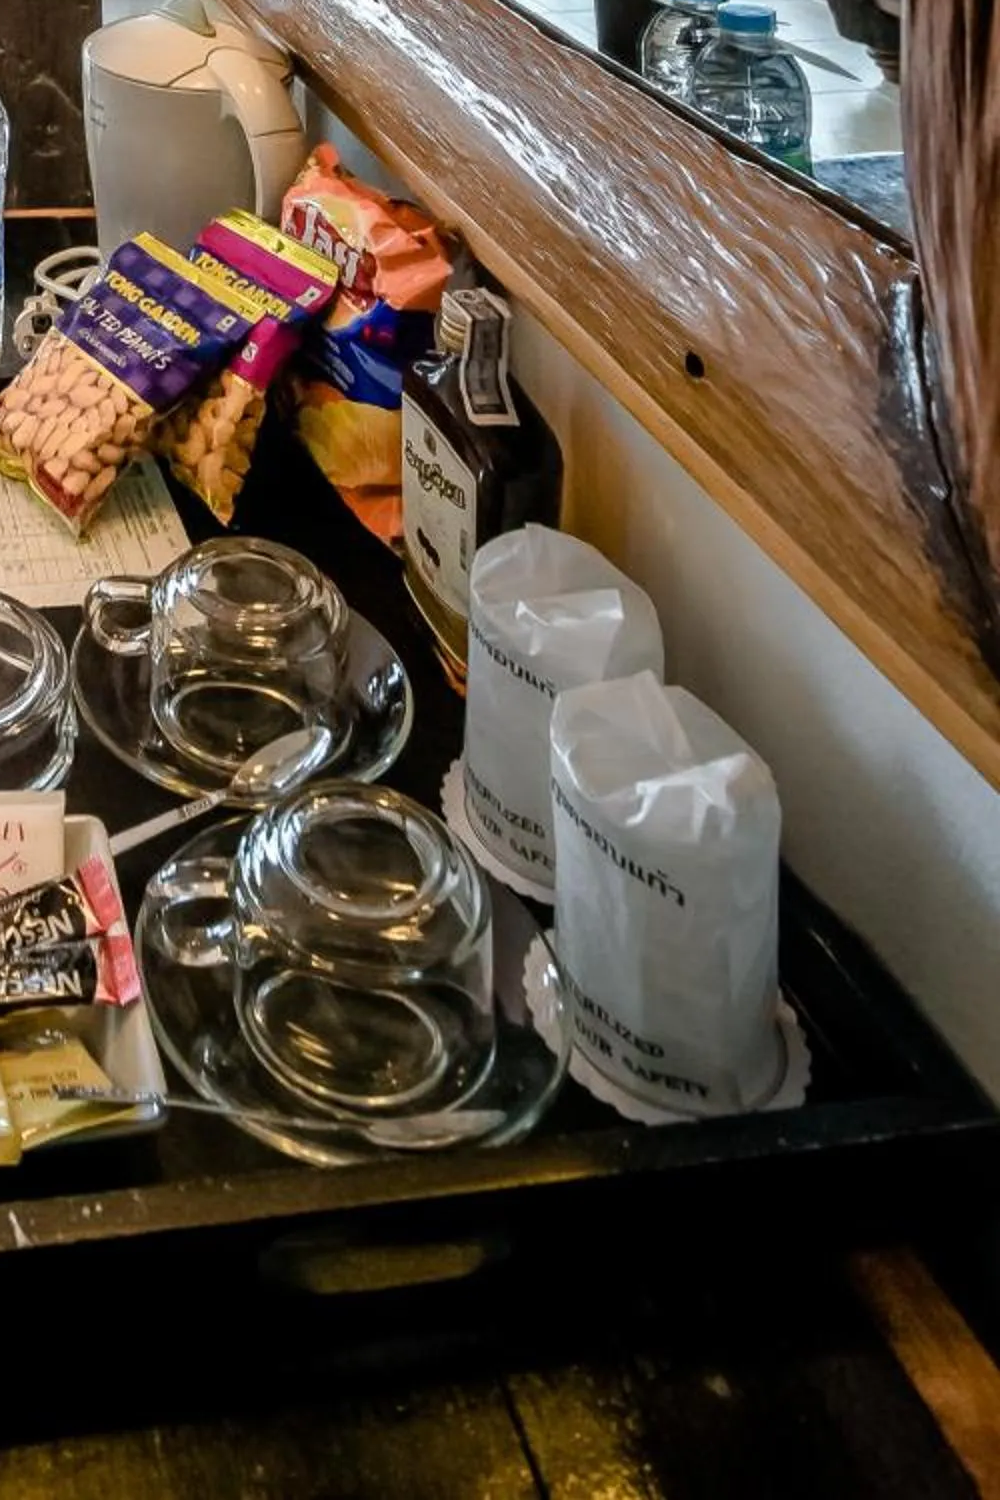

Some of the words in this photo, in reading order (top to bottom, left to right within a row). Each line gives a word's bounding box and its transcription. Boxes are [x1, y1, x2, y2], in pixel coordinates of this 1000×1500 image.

[105, 270, 144, 303] TONG
[138, 294, 201, 348] GARDEN
[195, 251, 236, 289] TONG
[232, 278, 293, 321] GARDEN
[78, 296, 122, 333] SALTED
[114, 325, 173, 371] PEANUTS
